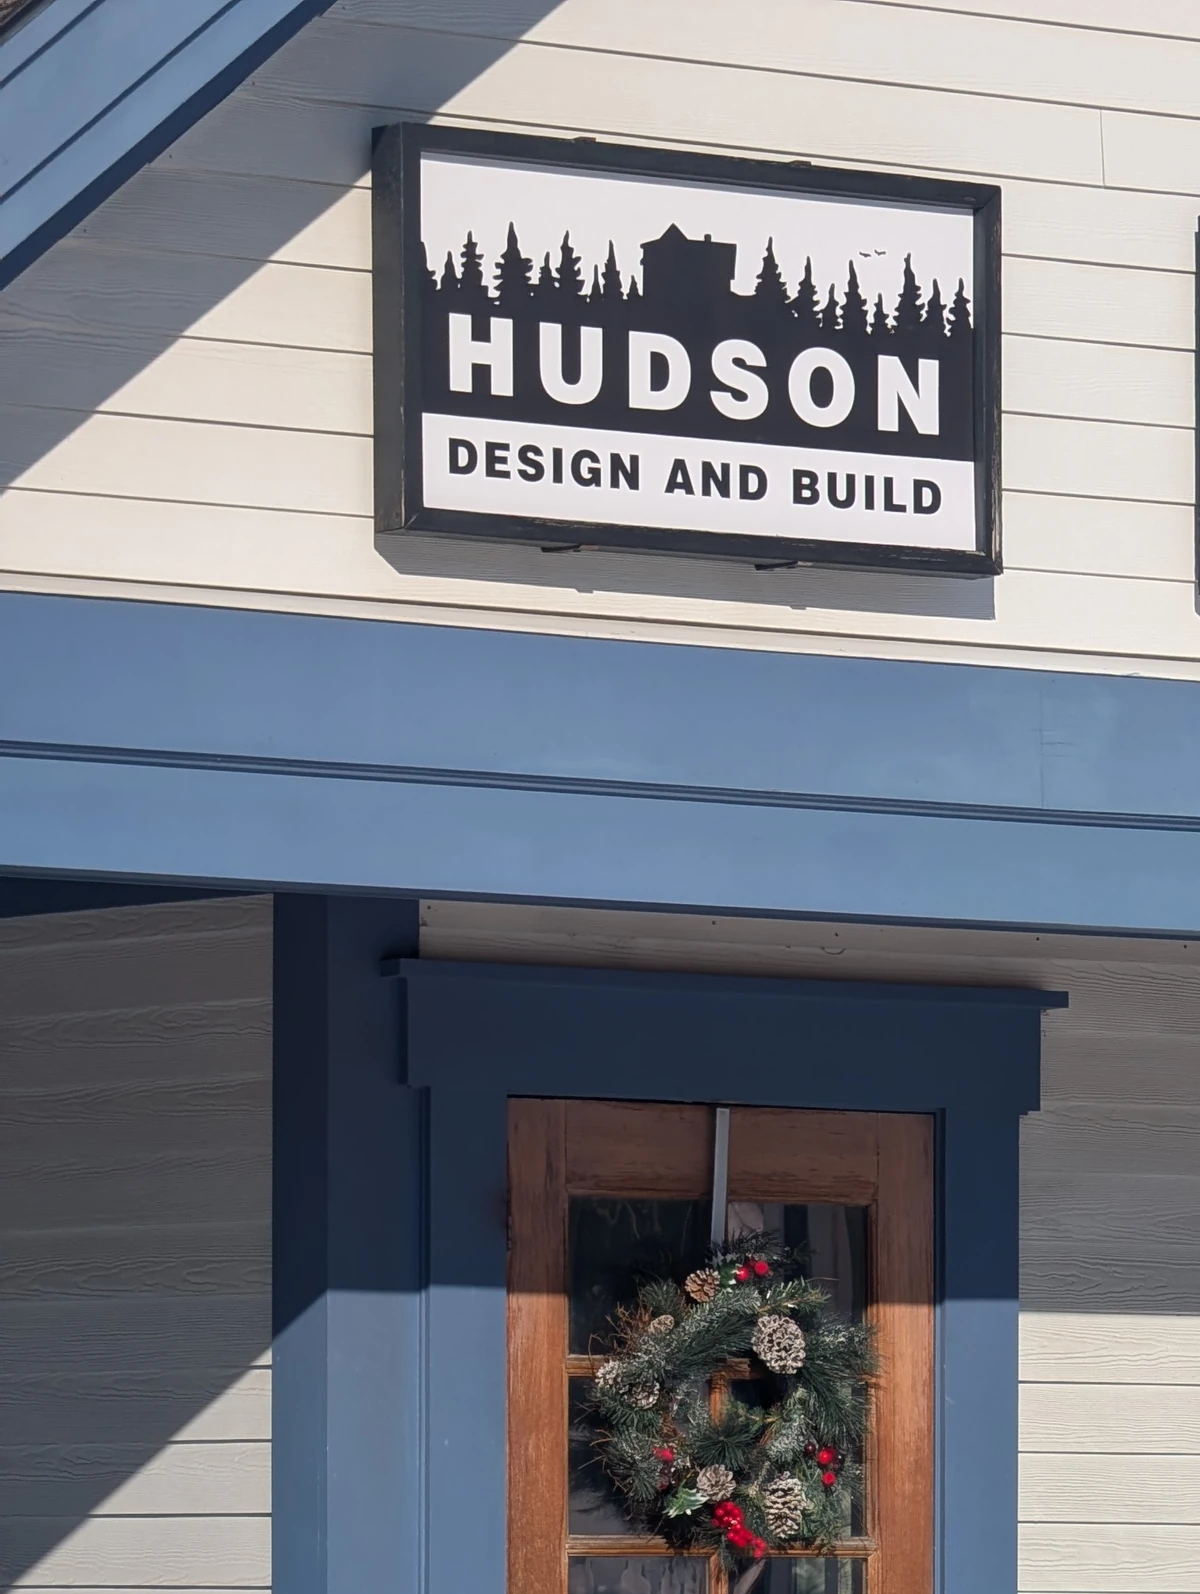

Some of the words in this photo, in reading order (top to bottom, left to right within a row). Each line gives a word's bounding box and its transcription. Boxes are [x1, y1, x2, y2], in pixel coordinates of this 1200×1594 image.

[447, 311, 940, 436] HUDSON
[448, 437, 640, 491] DESIGN
[664, 458, 768, 500] AND
[792, 468, 942, 514] BUILD
